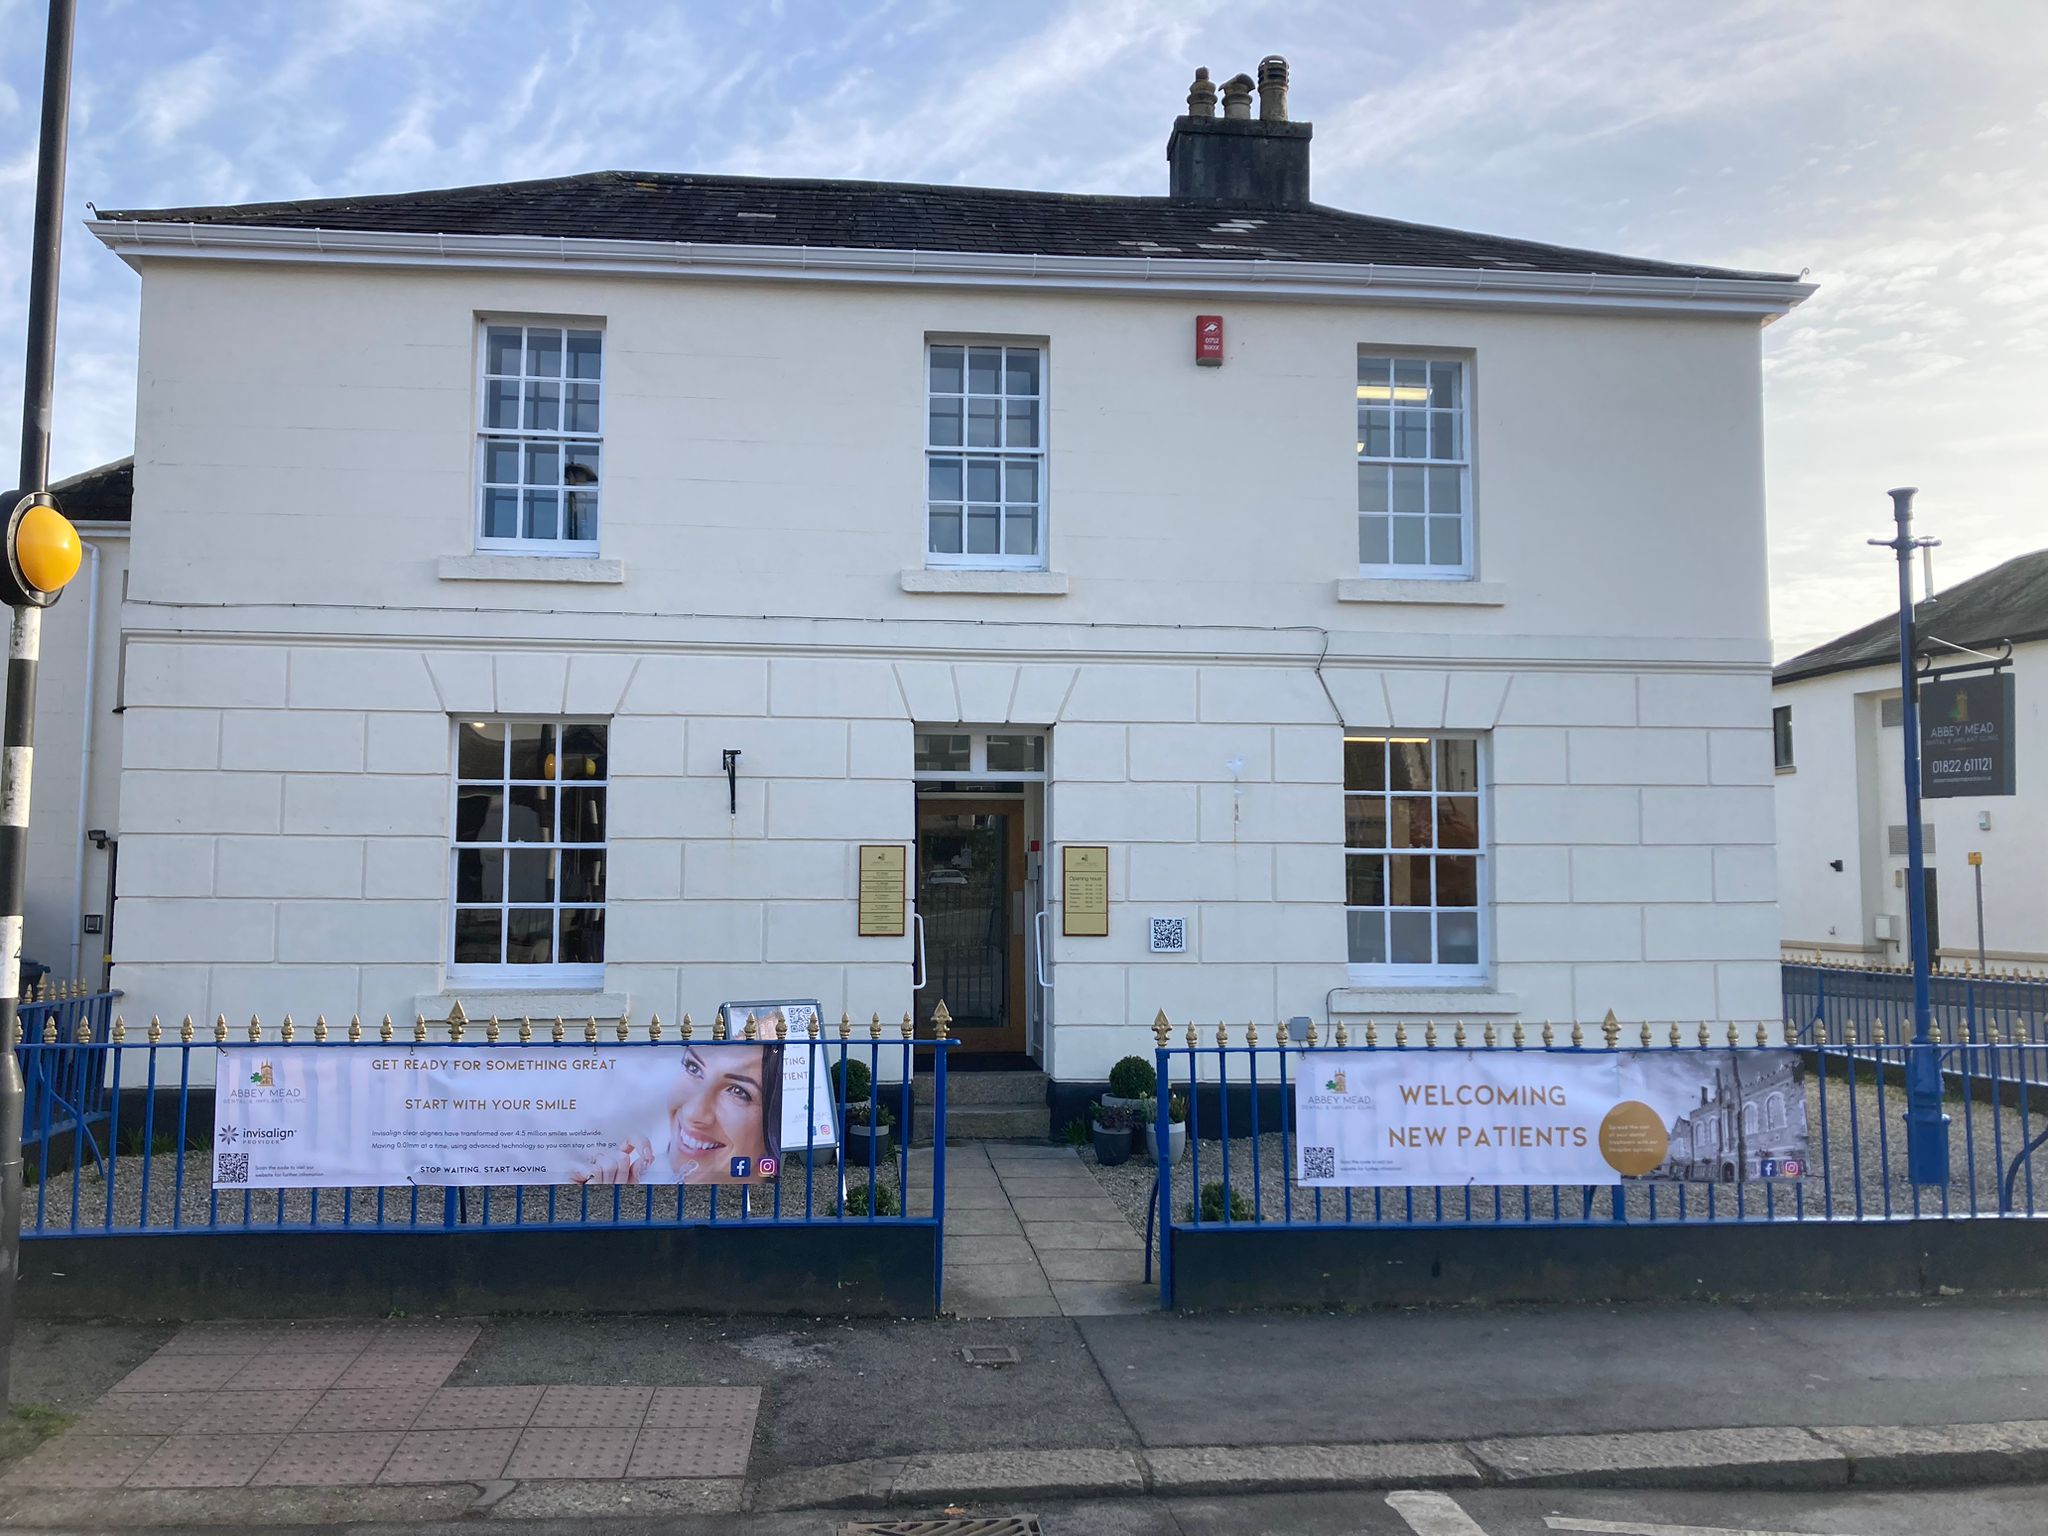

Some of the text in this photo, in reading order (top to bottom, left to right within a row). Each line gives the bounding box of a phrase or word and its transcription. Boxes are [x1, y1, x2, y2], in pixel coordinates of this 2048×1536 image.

[1931, 722, 1994, 737] ABBEY MEAD
[1932, 757, 1993, 773] 01822 611121
[372, 1059, 617, 1071] GET READY FOR SOMETHING GREAT
[230, 1088, 301, 1098] ABBEY MEAD
[1399, 1085, 1567, 1106] WELCOMING
[405, 1099, 577, 1110] START WITH YOUR SMILE
[1308, 1095, 1371, 1105] ABBEY MEAD
[242, 1128, 294, 1140] invisalign
[419, 1130, 443, 1138] aligners
[1388, 1127, 1588, 1148] NEW PATIENTS
